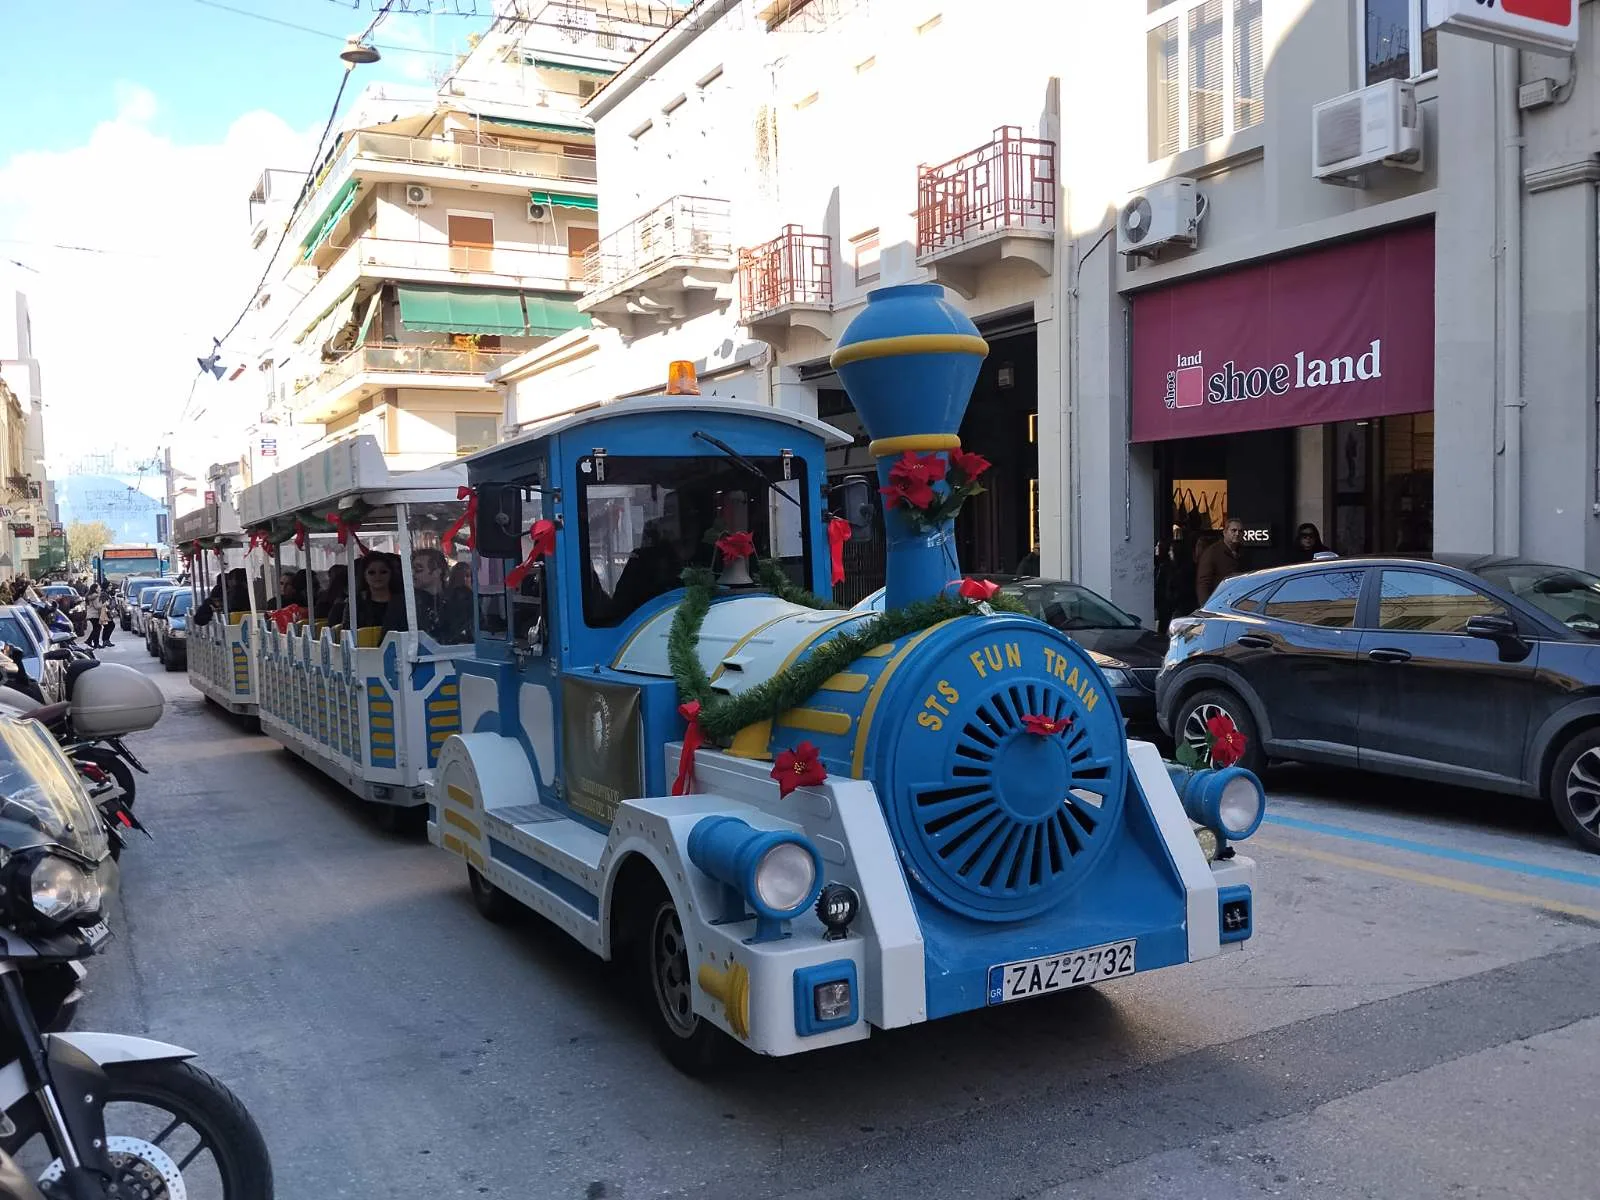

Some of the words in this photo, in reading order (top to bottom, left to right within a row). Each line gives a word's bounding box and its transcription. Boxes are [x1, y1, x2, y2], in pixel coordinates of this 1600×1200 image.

[1177, 350, 1202, 367] land
[1207, 360, 1290, 404] shoe
[1294, 339, 1381, 389] land
[1164, 370, 1175, 409] shoe
[917, 679, 959, 731] STS
[969, 642, 1022, 679] FUN
[1043, 647, 1099, 712] TRAIN
[990, 988, 1002, 998] GR
